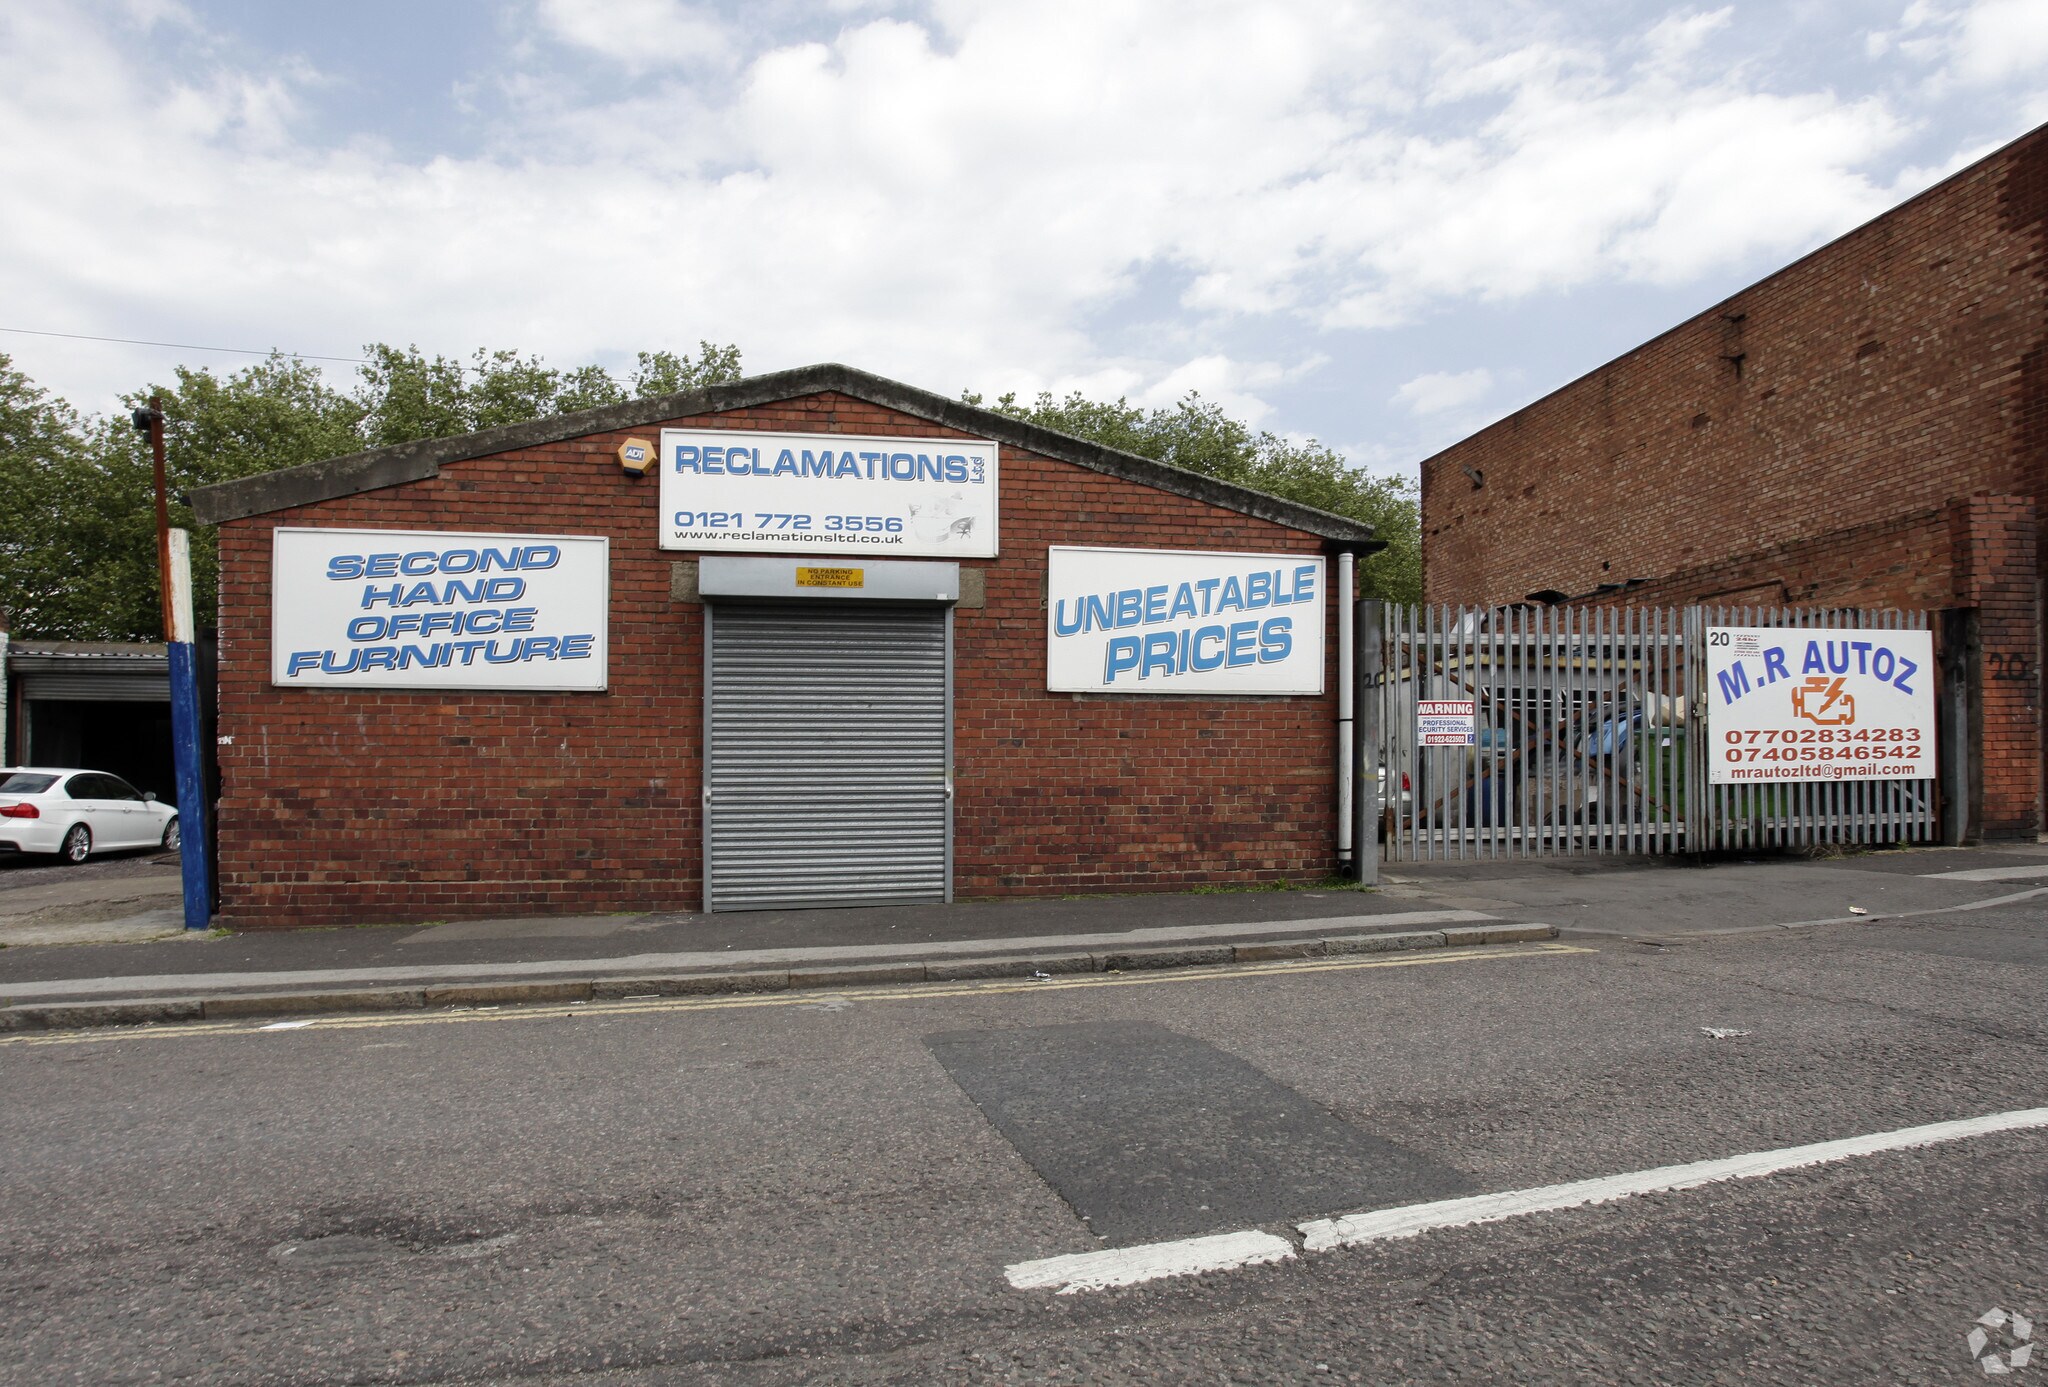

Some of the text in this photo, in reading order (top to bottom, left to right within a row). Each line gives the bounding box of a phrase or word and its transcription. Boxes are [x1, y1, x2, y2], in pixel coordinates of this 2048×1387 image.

[625, 448, 645, 459] ADT
[675, 445, 970, 483] RECLAMATIONS
[970, 456, 985, 484] Ltd
[674, 511, 903, 532] 0121 772 3556
[674, 531, 903, 545] www.reclamationsltd.co.uk
[326, 545, 562, 580] SECOND
[360, 576, 527, 610] HAND
[1054, 564, 1316, 637] UNBEATABLE
[346, 606, 536, 642] OFFICE
[1710, 631, 1729, 647] 20
[286, 633, 595, 678] FURNITURE
[1103, 616, 1293, 685] PRICES
[1801, 640, 1918, 696] AUTOZ
[1725, 728, 1921, 744] 07702834283
[1725, 745, 1922, 762] 07405846542
[1731, 763, 1915, 780] mrautozltd@gmail.com
